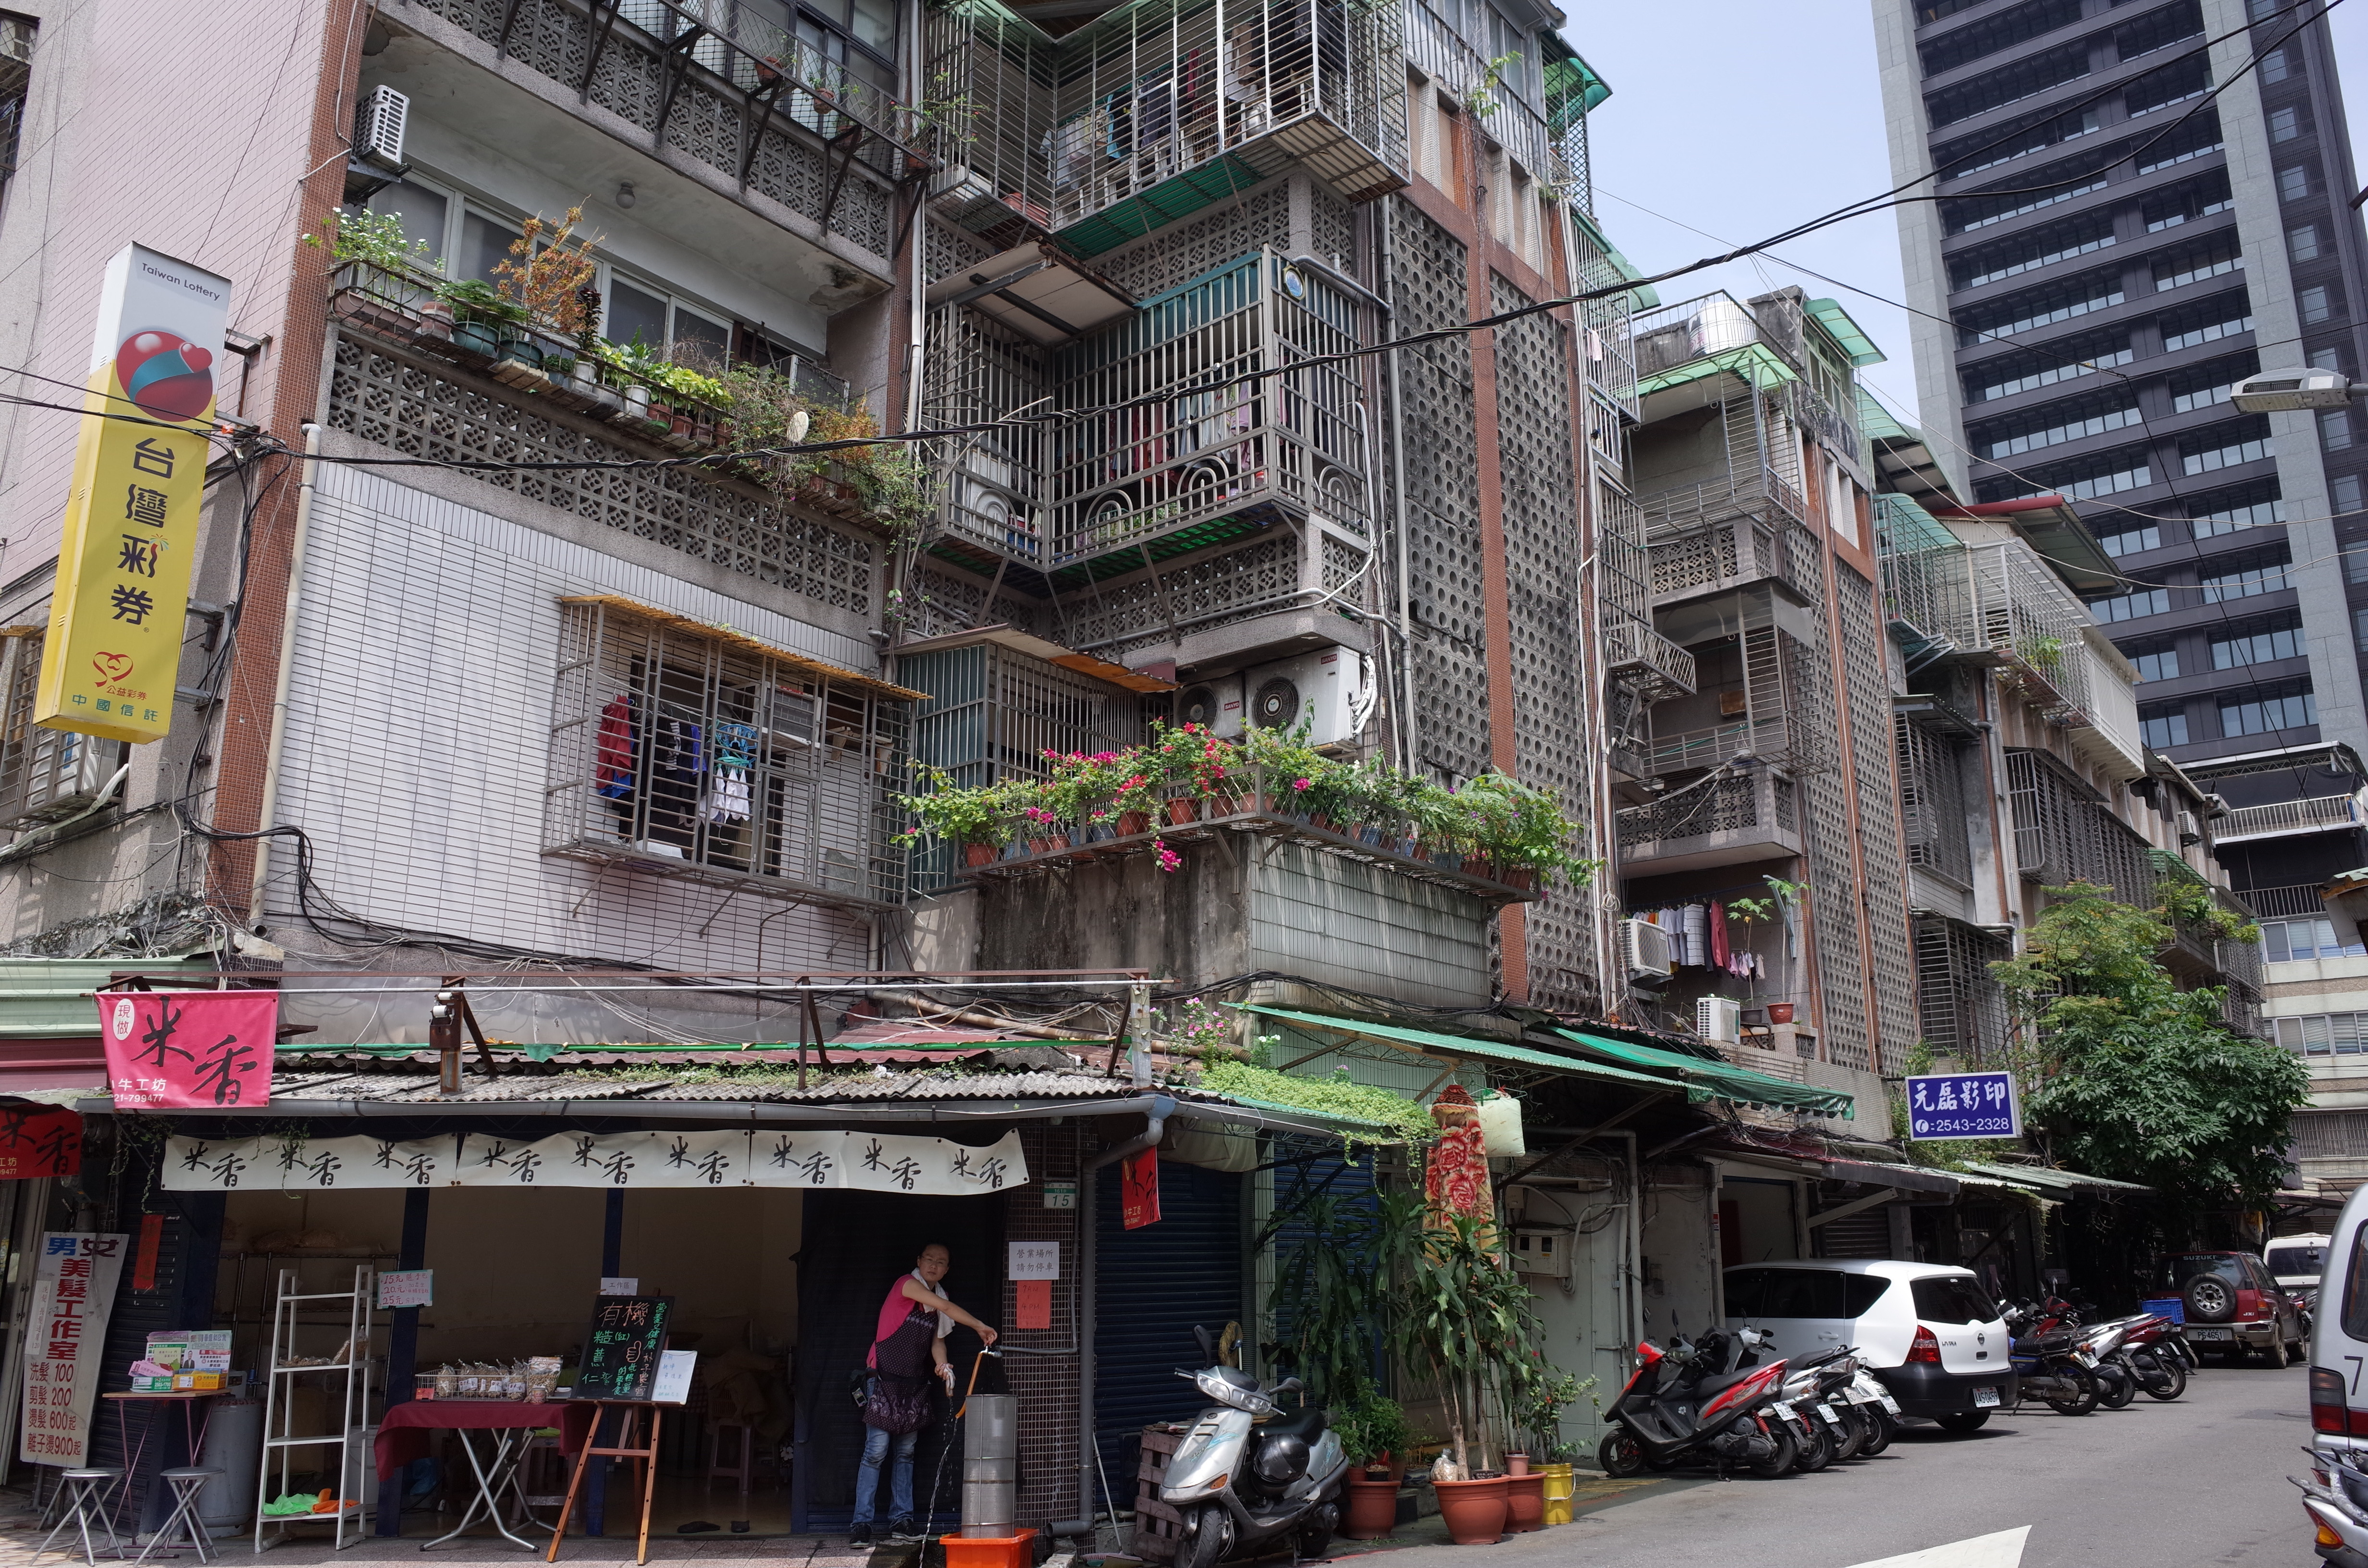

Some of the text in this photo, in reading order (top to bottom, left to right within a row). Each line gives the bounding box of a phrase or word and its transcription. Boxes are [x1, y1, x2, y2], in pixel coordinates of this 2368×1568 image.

[142, 263, 221, 301] Taiwan Lottery
[111, 438, 175, 625] 台灣彩券
[1321, 655, 1337, 663] SANYO
[107, 685, 148, 700] 公益彩券
[1225, 702, 1240, 710] SANYO
[72, 694, 159, 722] 中國信託
[117, 1004, 131, 1035] 現做
[131, 995, 258, 1105] 米香
[1914, 1080, 2006, 1112] 元磊影印
[179, 1140, 435, 1187] 米香 米香 米香
[477, 1135, 729, 1185] 米香 米香 米香
[769, 1135, 1007, 1190] 米香 米香 米香
[1053, 1195, 1070, 1207] 15
[47, 1237, 119, 1258] 男女
[1016, 1248, 1054, 1259] 營業場所
[1016, 1262, 1054, 1274] 請勿停車
[46, 1258, 92, 1360] 美髮工作室
[598, 1300, 651, 1327] 有機
[30, 1362, 74, 1383] 洗髮 100
[2344, 1355, 2364, 1396] 7
[29, 1385, 72, 1407] 剪髮 200
[28, 1408, 47, 1429] 燙髮
